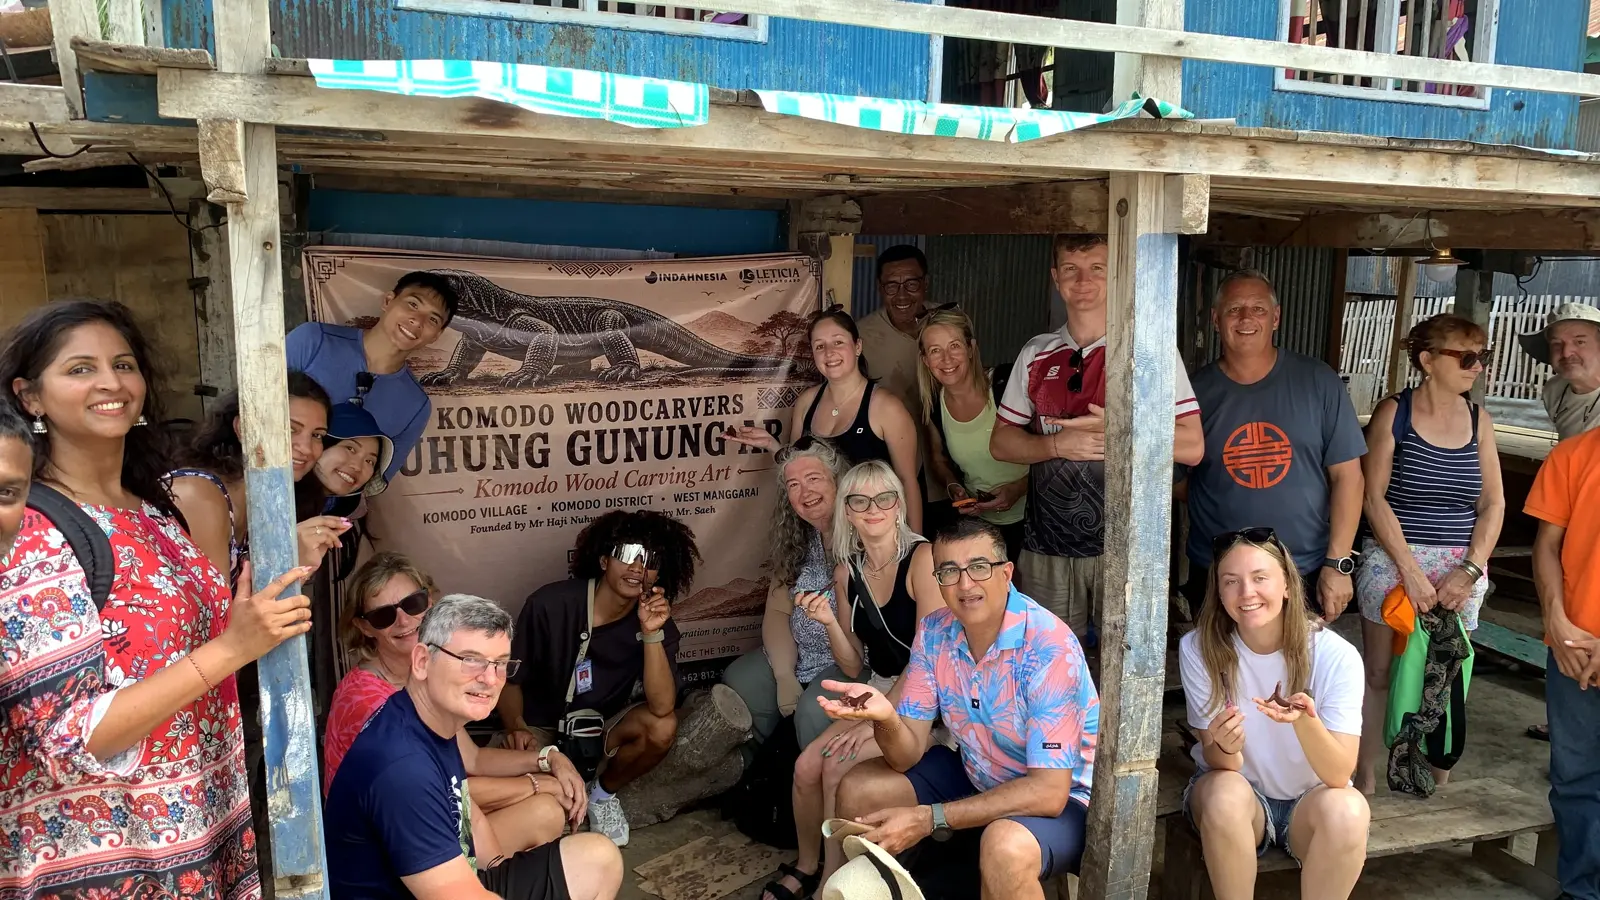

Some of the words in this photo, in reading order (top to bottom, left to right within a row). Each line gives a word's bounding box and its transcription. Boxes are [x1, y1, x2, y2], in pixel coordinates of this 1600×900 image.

[659, 273, 728, 282] INDAHNESIA
[755, 268, 800, 279] LETICIA
[437, 404, 555, 429] KOMODO
[564, 393, 744, 424] WOODCARVERS
[566, 421, 727, 466] GUNUNG
[473, 475, 558, 498] Komodo
[564, 471, 618, 492] Wood
[625, 466, 698, 488] Carving
[700, 463, 731, 482] Art
[423, 508, 477, 524] KOMODO
[480, 504, 528, 518] VILLAGE
[551, 499, 601, 513] KOMODO
[605, 495, 654, 508] DISTRICT
[673, 492, 701, 503] WEST
[703, 487, 759, 501] MANGGARAI
[470, 522, 512, 534] Founded
[514, 521, 526, 530] by
[529, 519, 544, 529] Mr
[547, 516, 568, 528] Haji
[676, 507, 692, 516] Mr.
[694, 506, 716, 515] Saeh
[712, 627, 720, 635] to
[699, 648, 715, 657] THE
[717, 645, 741, 654] 1970s
[681, 672, 699, 682] +62
